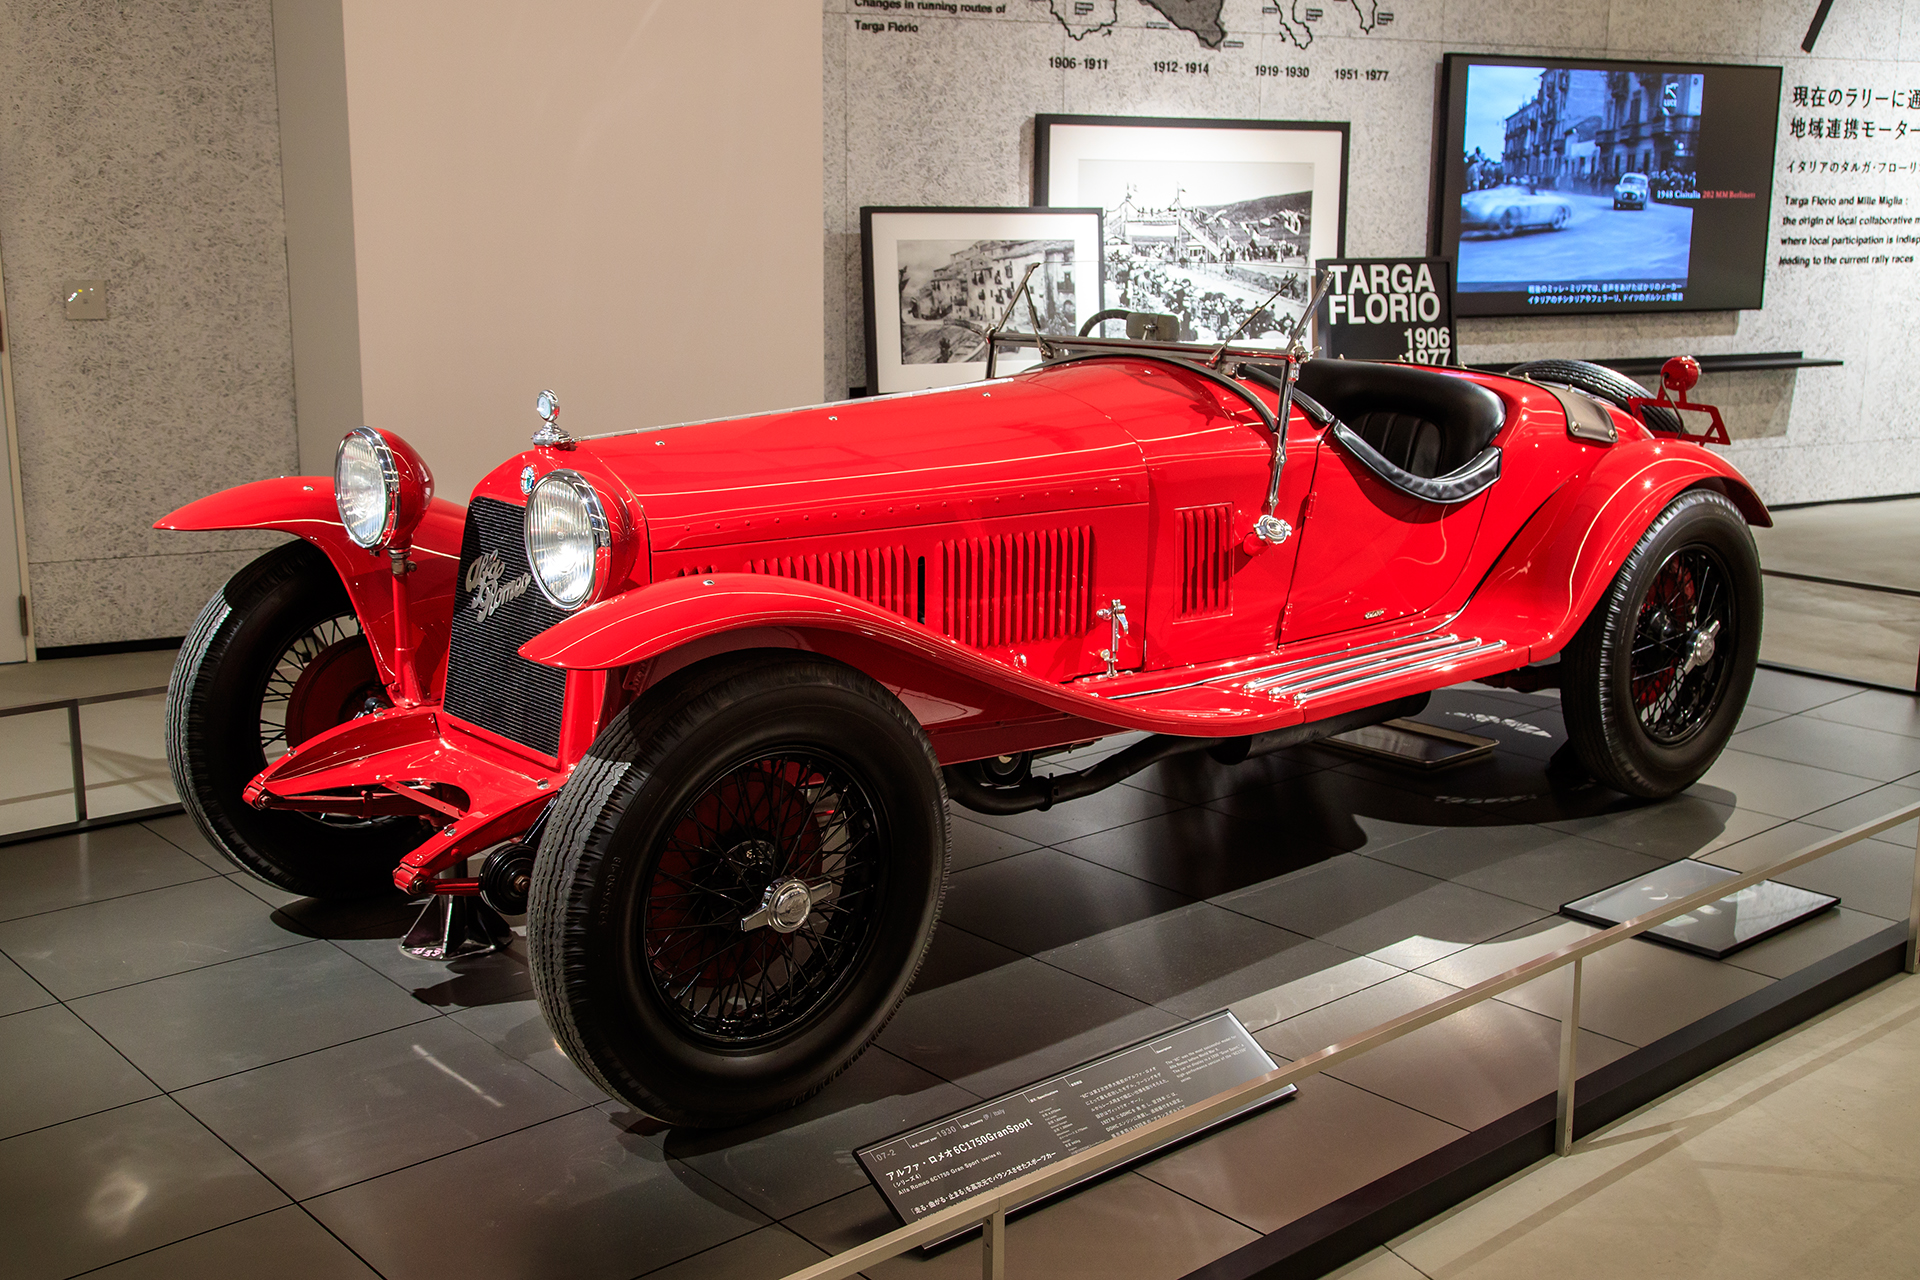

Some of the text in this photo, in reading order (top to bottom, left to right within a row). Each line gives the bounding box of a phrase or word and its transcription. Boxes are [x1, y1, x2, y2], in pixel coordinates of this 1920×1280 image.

[855, 0, 1006, 14] Changes in running routes of
[854, 20, 918, 34] Targa Florio
[1790, 117, 1920, 140] 地域連携モーター
[1785, 195, 1809, 208] Targa
[1812, 196, 1836, 205] Florio
[1839, 196, 1854, 205] and
[1857, 196, 1876, 205] Mille
[1879, 196, 1903, 208] Miglia
[1783, 217, 1796, 225] the
[1799, 216, 1824, 227] origin
[1826, 216, 1834, 225] of
[1837, 216, 1857, 225] local
[1859, 216, 1912, 225] collaborative
[1781, 236, 1806, 245] where
[1809, 236, 1830, 245] local
[1832, 236, 1884, 247] participation
[1886, 235, 1893, 244] is
[1779, 255, 1914, 268] leading to the current rally races
[1328, 263, 1436, 295] TARGA
[1328, 292, 1440, 325] FLORIO
[1404, 326, 1450, 349] 1906
[1405, 348, 1451, 366] 1977
[466, 549, 505, 600] Alfa
[476, 573, 531, 622] Romeo
[992, 1108, 1006, 1117] Italy
[936, 1126, 956, 1137] 1930
[875, 1149, 896, 1161] 07-2
[909, 1179, 929, 1189] Romeo
[929, 1170, 950, 1182] 6C1750
[950, 1165, 964, 1174] Gran
[963, 1159, 980, 1169] Sport
